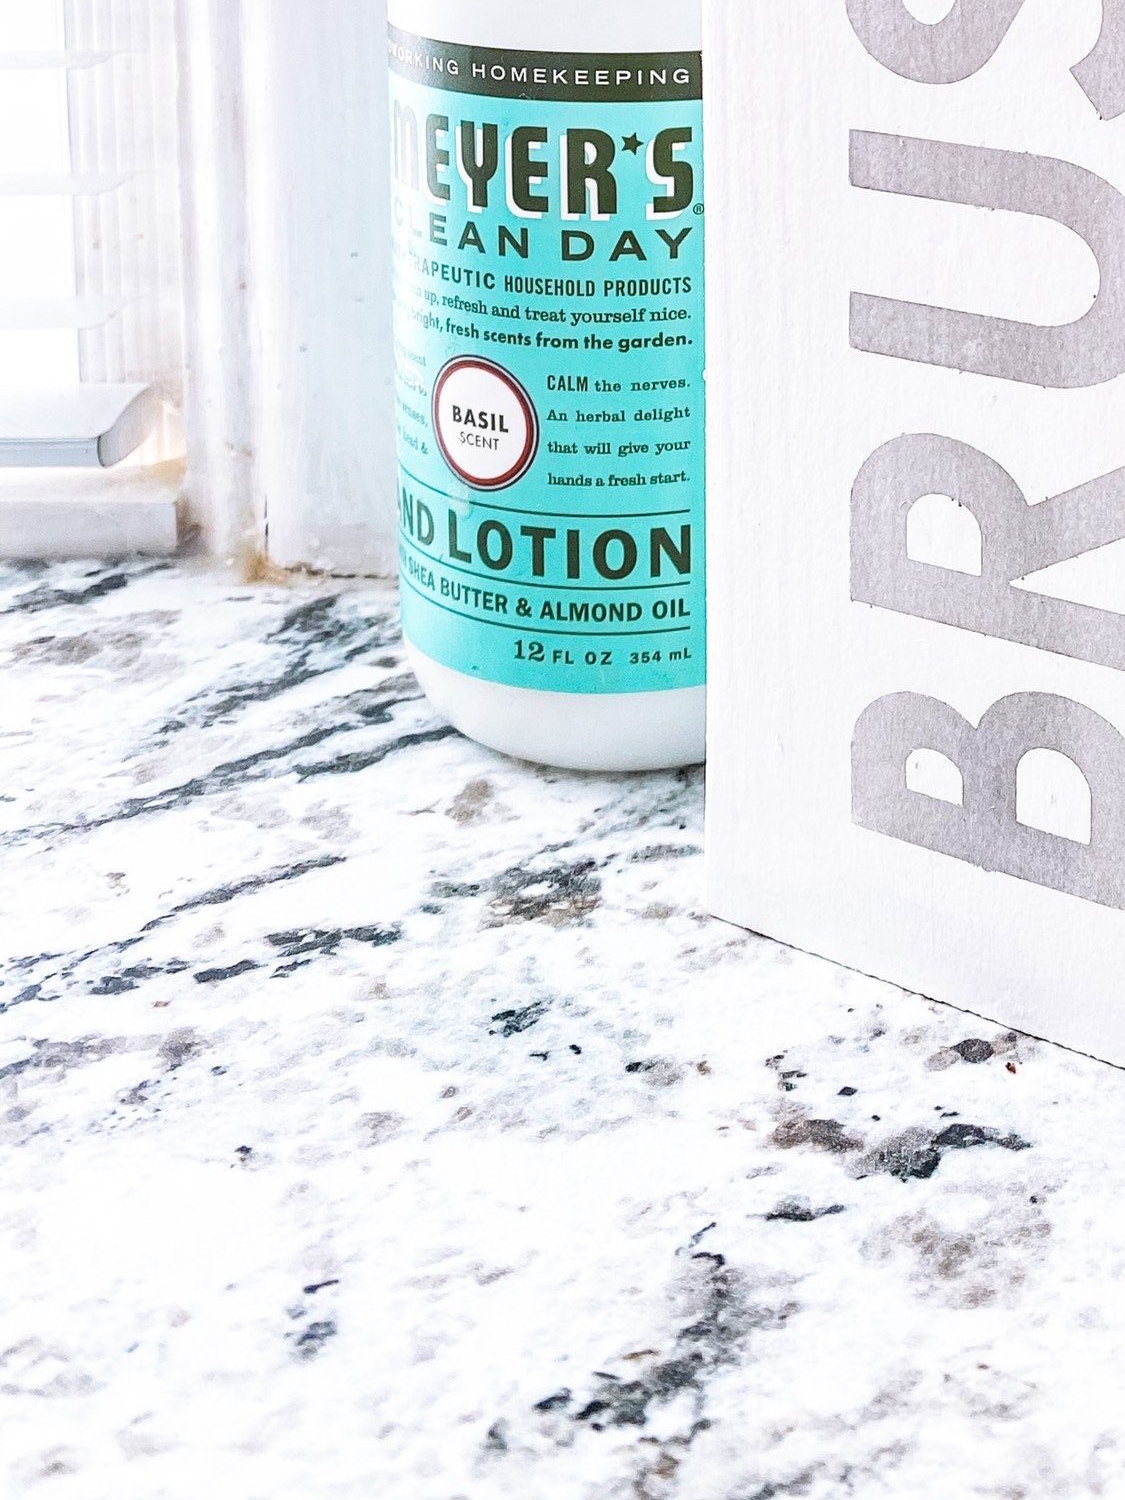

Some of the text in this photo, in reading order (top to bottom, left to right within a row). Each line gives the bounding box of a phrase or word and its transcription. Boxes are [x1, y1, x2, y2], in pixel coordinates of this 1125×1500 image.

[472, 63, 690, 85] HOMEKEEPING
[561, 227, 693, 261] DAY
[504, 275, 595, 297] HOUSEHOLD
[603, 275, 692, 297] PRODUCTS
[424, 289, 440, 306] up,
[442, 295, 488, 315] refresh
[491, 305, 521, 320] and
[525, 306, 567, 323] treat
[570, 307, 646, 325] yourself
[649, 305, 691, 321] nice.
[445, 317, 479, 339] fresh
[483, 329, 531, 346] scents
[536, 332, 579, 349] from
[584, 333, 613, 350] the
[618, 331, 693, 352] garden.
[546, 374, 691, 392] CALM the nerves.
[452, 405, 509, 433] BASIL
[546, 406, 691, 423] An herbal delight
[459, 431, 499, 451] SCENT
[547, 438, 691, 458] that will give your
[547, 471, 691, 488] hands a fresh start.
[397, 486, 691, 580] ND LOTION
[409, 556, 691, 623] SHEA BUTTER & ALMOND OIL
[513, 639, 692, 665] 12 FL OZ 354 mL
